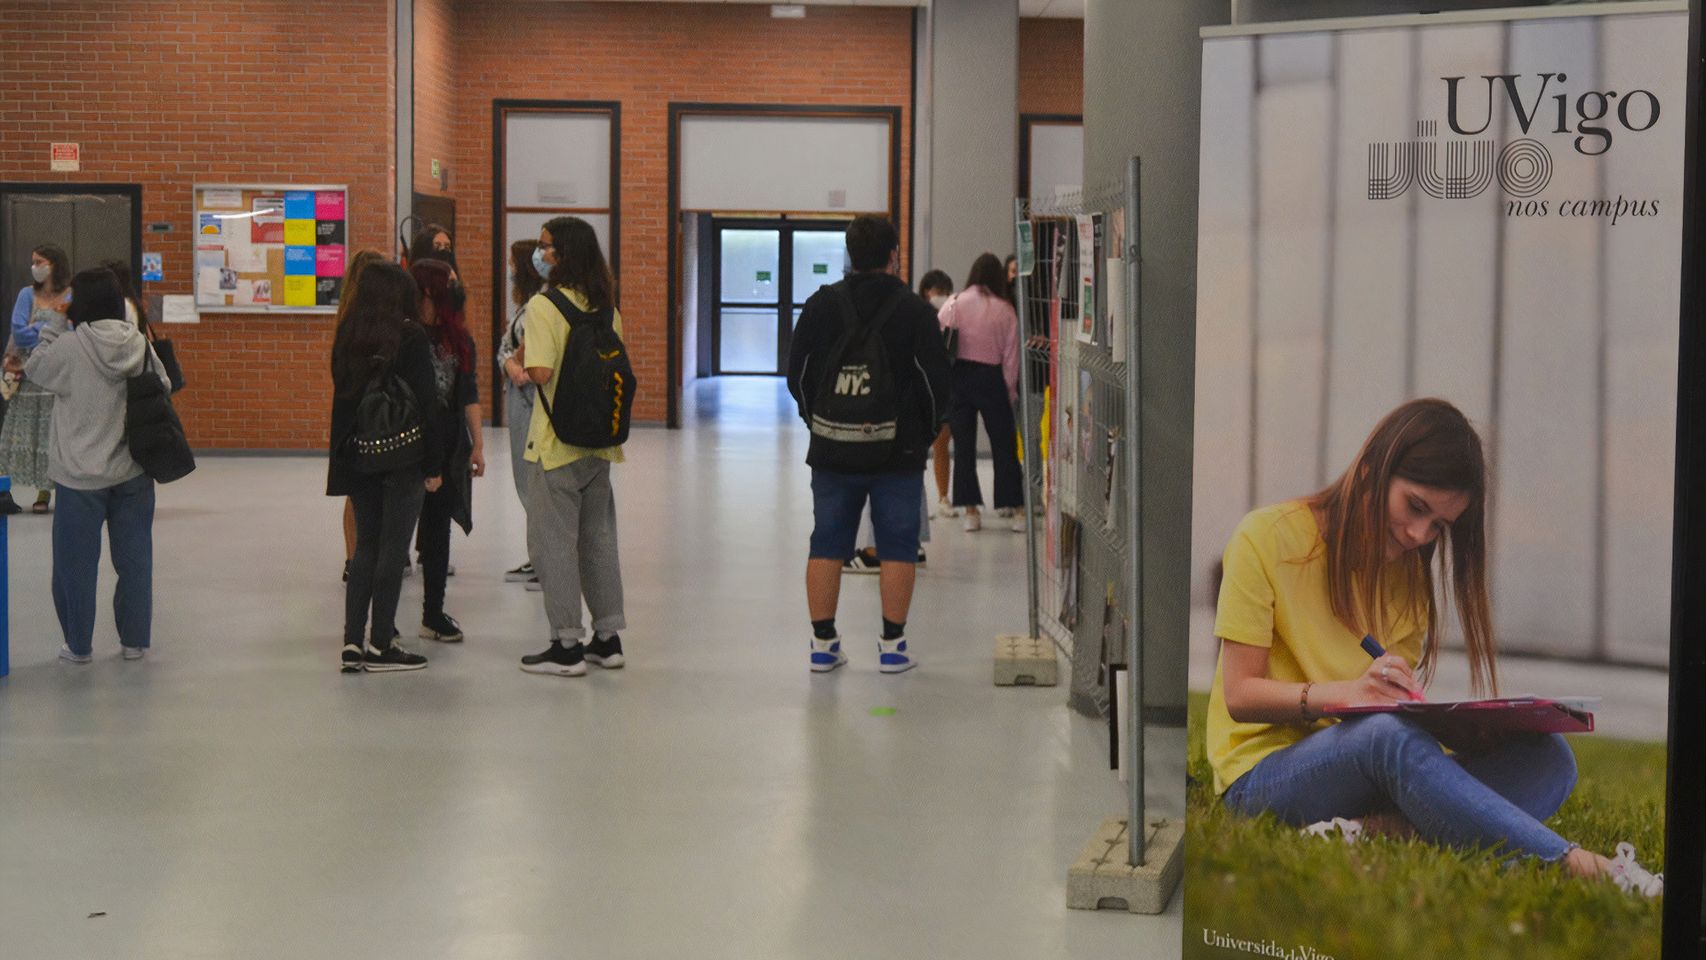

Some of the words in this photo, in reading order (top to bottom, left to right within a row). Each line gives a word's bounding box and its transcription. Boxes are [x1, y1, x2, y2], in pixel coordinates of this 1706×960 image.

[1440, 73, 1661, 156] UVigo
[1507, 198, 1549, 217] nos
[1558, 195, 1660, 226] campus
[835, 371, 871, 396] NYC
